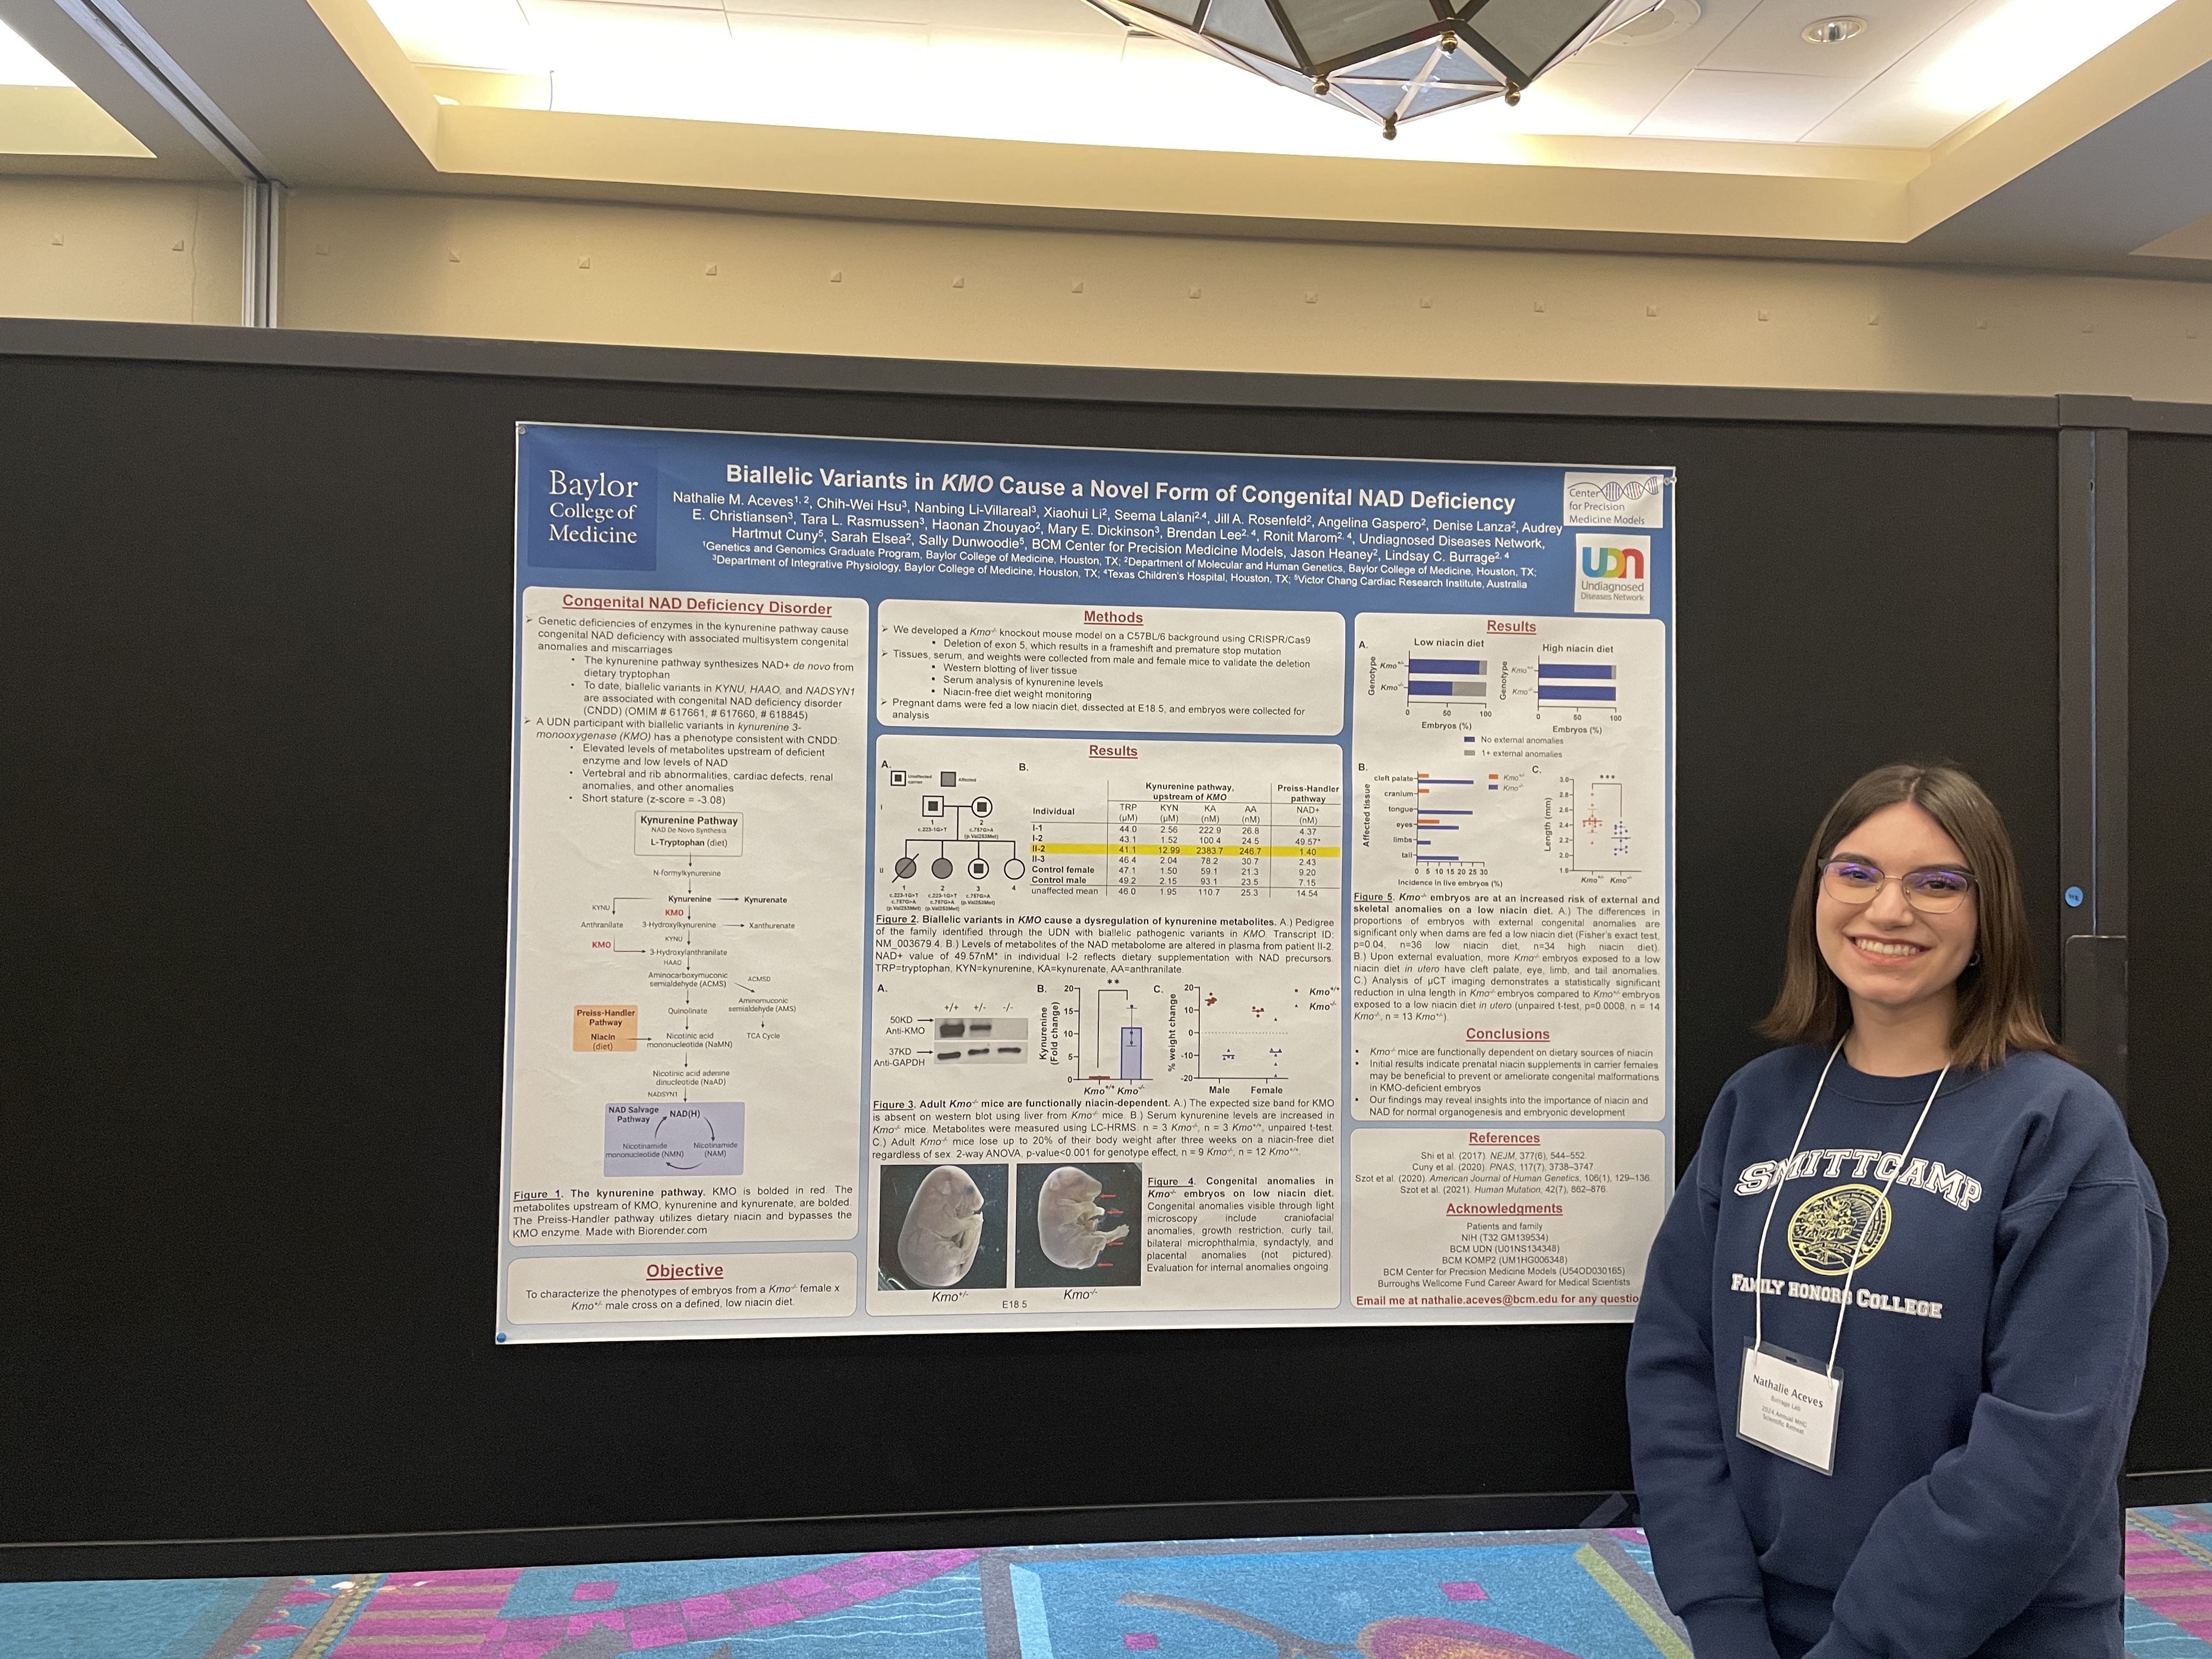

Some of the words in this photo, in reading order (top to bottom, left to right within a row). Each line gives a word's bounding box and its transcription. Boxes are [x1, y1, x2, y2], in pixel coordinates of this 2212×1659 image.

[549, 470, 639, 501] Baylor
[727, 464, 813, 486] Biallelic
[819, 468, 907, 489] Variants
[915, 472, 933, 490] in
[941, 473, 993, 493] KMO
[1000, 476, 1065, 496] Cause
[1071, 483, 1083, 496] a
[1091, 479, 1148, 499] Novel
[1156, 482, 1208, 501] Form
[1216, 484, 1237, 502] of
[1242, 484, 1352, 510] Congenital
[1359, 489, 1403, 507] NAD
[1411, 490, 1515, 515] Deficiency
[1570, 489, 1599, 497] Center
[550, 502, 614, 523] College
[617, 505, 637, 519] of
[1570, 501, 1581, 510] for
[1584, 502, 1624, 511] Precision
[1614, 516, 1645, 524] Models
[549, 524, 637, 543] Medicine
[1359, 532, 1434, 549] Undiagnosed
[1438, 535, 1491, 548] Diseases
[1494, 536, 1545, 549] Network,
[1032, 538, 1061, 550] BCM
[1065, 539, 1105, 551] Center
[1109, 541, 1125, 552] for
[1128, 541, 1181, 554] Precision
[1186, 543, 1238, 556] Medicine
[1242, 545, 1286, 558] Models,
[1290, 546, 1324, 558] Jason
[1327, 575, 1357, 587] Chang
[1360, 576, 1396, 586] Cardiac
[1398, 577, 1443, 587] Research
[1446, 578, 1484, 589] Institute,
[1486, 578, 1527, 589] Australia
[1581, 581, 1644, 592] Undiagnosed
[1581, 592, 1612, 600] Diseases
[563, 594, 644, 611] Congenital
[649, 596, 682, 609] NAD
[687, 597, 764, 615] Deficiency
[769, 601, 832, 614] Disorder
[1084, 610, 1143, 623] Methods
[1487, 619, 1536, 632] Results
[538, 629, 588, 641] congenital
[591, 630, 613, 640] NAD
[617, 631, 664, 643] deficiency
[667, 633, 686, 642] with
[689, 633, 739, 643] associated
[742, 635, 798, 647] multisystem
[801, 637, 848, 648] congenital
[1414, 639, 1434, 647] Low
[1436, 638, 1465, 647] niacin
[1467, 639, 1484, 648] diet
[1543, 644, 1564, 654] High
[1566, 644, 1594, 653] niacin
[1596, 645, 1613, 653] diet
[584, 668, 616, 679] dietary
[619, 669, 669, 680] tryptophan
[943, 687, 992, 696] Niacin-free
[995, 689, 1011, 697] diet
[1013, 689, 1043, 699] weight
[1046, 691, 1092, 701] monitoring
[1090, 744, 1137, 756] Results
[582, 758, 620, 767] enzyme
[623, 757, 641, 765] and
[644, 757, 660, 765] low
[663, 758, 691, 766] levels
[693, 758, 703, 766] of
[706, 758, 727, 767] NAD
[641, 816, 695, 826] Kynurenine
[697, 816, 738, 827] Pathway
[651, 839, 704, 848] L-Tryptophan
[707, 838, 727, 848] (diet)
[589, 1019, 623, 1028] Pathway
[1051, 1002, 1060, 1039] change)
[1466, 1028, 1550, 1039] Conclusions
[1051, 1042, 1060, 1065] (Fold
[874, 1059, 925, 1067] Anti-GAPDH
[1369, 1107, 1390, 1115] NAD
[1393, 1107, 1404, 1115] for
[1407, 1108, 1436, 1116] normal
[1439, 1109, 1502, 1118] organogenesis
[1505, 1108, 1521, 1116] and
[1523, 1108, 1568, 1118] embryonic
[1570, 1108, 1625, 1118] development
[1469, 1132, 1540, 1143] References
[1734, 1149, 1982, 1211] SMITTCAMP
[1446, 1202, 1562, 1217] Acknowledgments
[1147, 1213, 1197, 1226] microscopy
[1226, 1214, 1256, 1222] include
[1284, 1213, 1334, 1222] craniofacial
[513, 1228, 538, 1238] KMO
[541, 1229, 580, 1239] enzyme.
[586, 1227, 613, 1236] Made
[615, 1227, 635, 1235] with
[638, 1226, 707, 1235] Biorender.com
[1467, 1222, 1499, 1230] Patients
[1520, 1222, 1543, 1232] family
[1480, 1233, 1498, 1243] (T32
[1500, 1233, 1548, 1243] GM139534)
[1465, 1256, 1496, 1264] KOMP2
[647, 1263, 723, 1280] Objective
[1357, 1295, 1385, 1305] Email
[1408, 1296, 1418, 1305] at
[1421, 1293, 1558, 1305] nathalie.aceves@bcm.edu
[1561, 1294, 1576, 1303] for
[1579, 1295, 1597, 1305] any
[1601, 1294, 1639, 1305] questio
[1731, 1273, 1785, 1295] FAMILY
[1857, 1289, 1943, 1318] COLLEGE
[1753, 1374, 1788, 1395] Nathalie
[1791, 1389, 1823, 1408] Aceves
[1792, 1401, 1801, 1412] Lab
[1762, 1406, 1775, 1415] 2024
[1775, 1411, 1793, 1423] Annual
[1763, 1414, 1785, 1427] Scientific
[1786, 1423, 1804, 1435] Retreat
